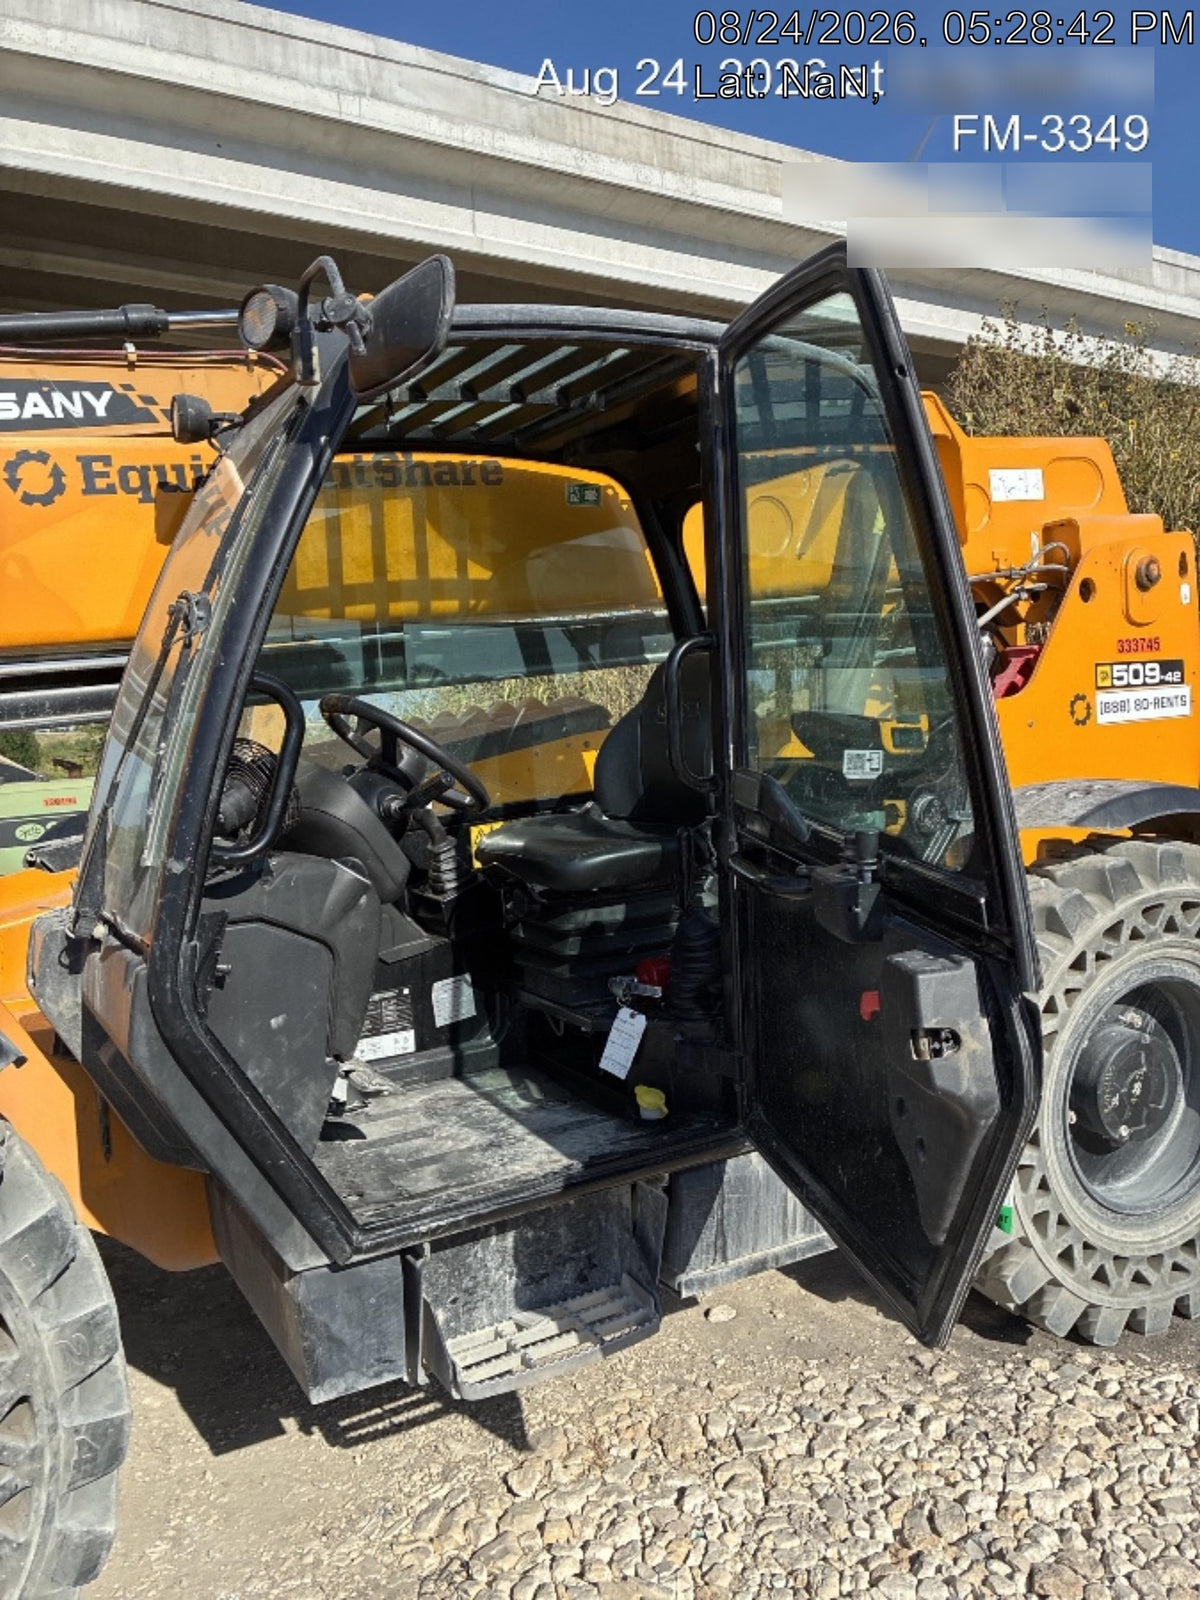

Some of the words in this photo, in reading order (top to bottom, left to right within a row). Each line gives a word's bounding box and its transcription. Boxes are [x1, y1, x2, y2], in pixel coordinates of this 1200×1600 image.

[0, 390, 114, 420] SANY
[1117, 637, 1160, 653] 333745
[1112, 663, 1182, 687] 509-42
